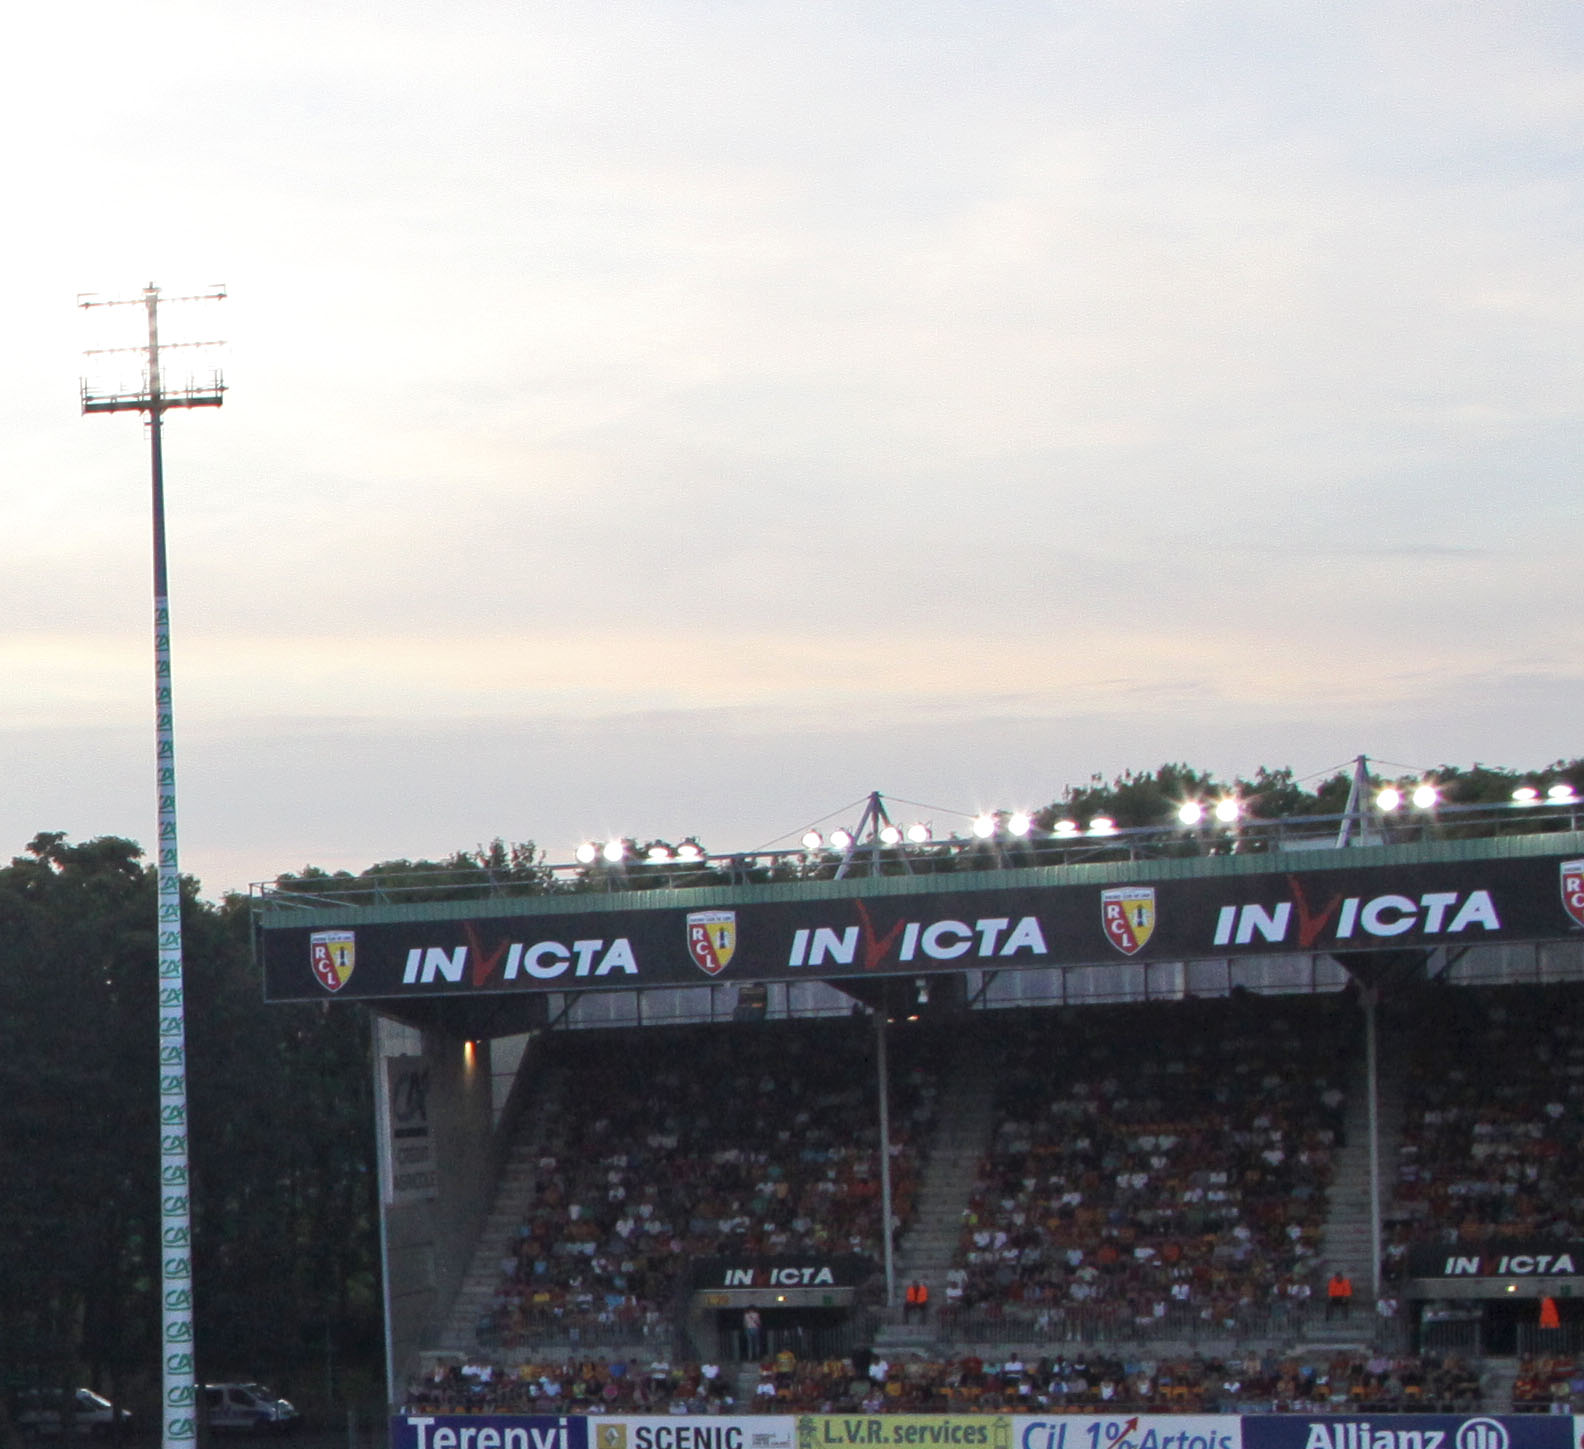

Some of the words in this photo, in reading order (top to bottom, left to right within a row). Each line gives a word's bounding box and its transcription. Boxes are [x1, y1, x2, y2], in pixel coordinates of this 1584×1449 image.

[789, 900, 1048, 967] INVICTA
[1214, 876, 1502, 946] INVICTA
[403, 920, 638, 985] INVICTA
[1445, 1254, 1575, 1274] INICTA
[824, 1420, 889, 1444] L.V.R.
[893, 1419, 987, 1444] services
